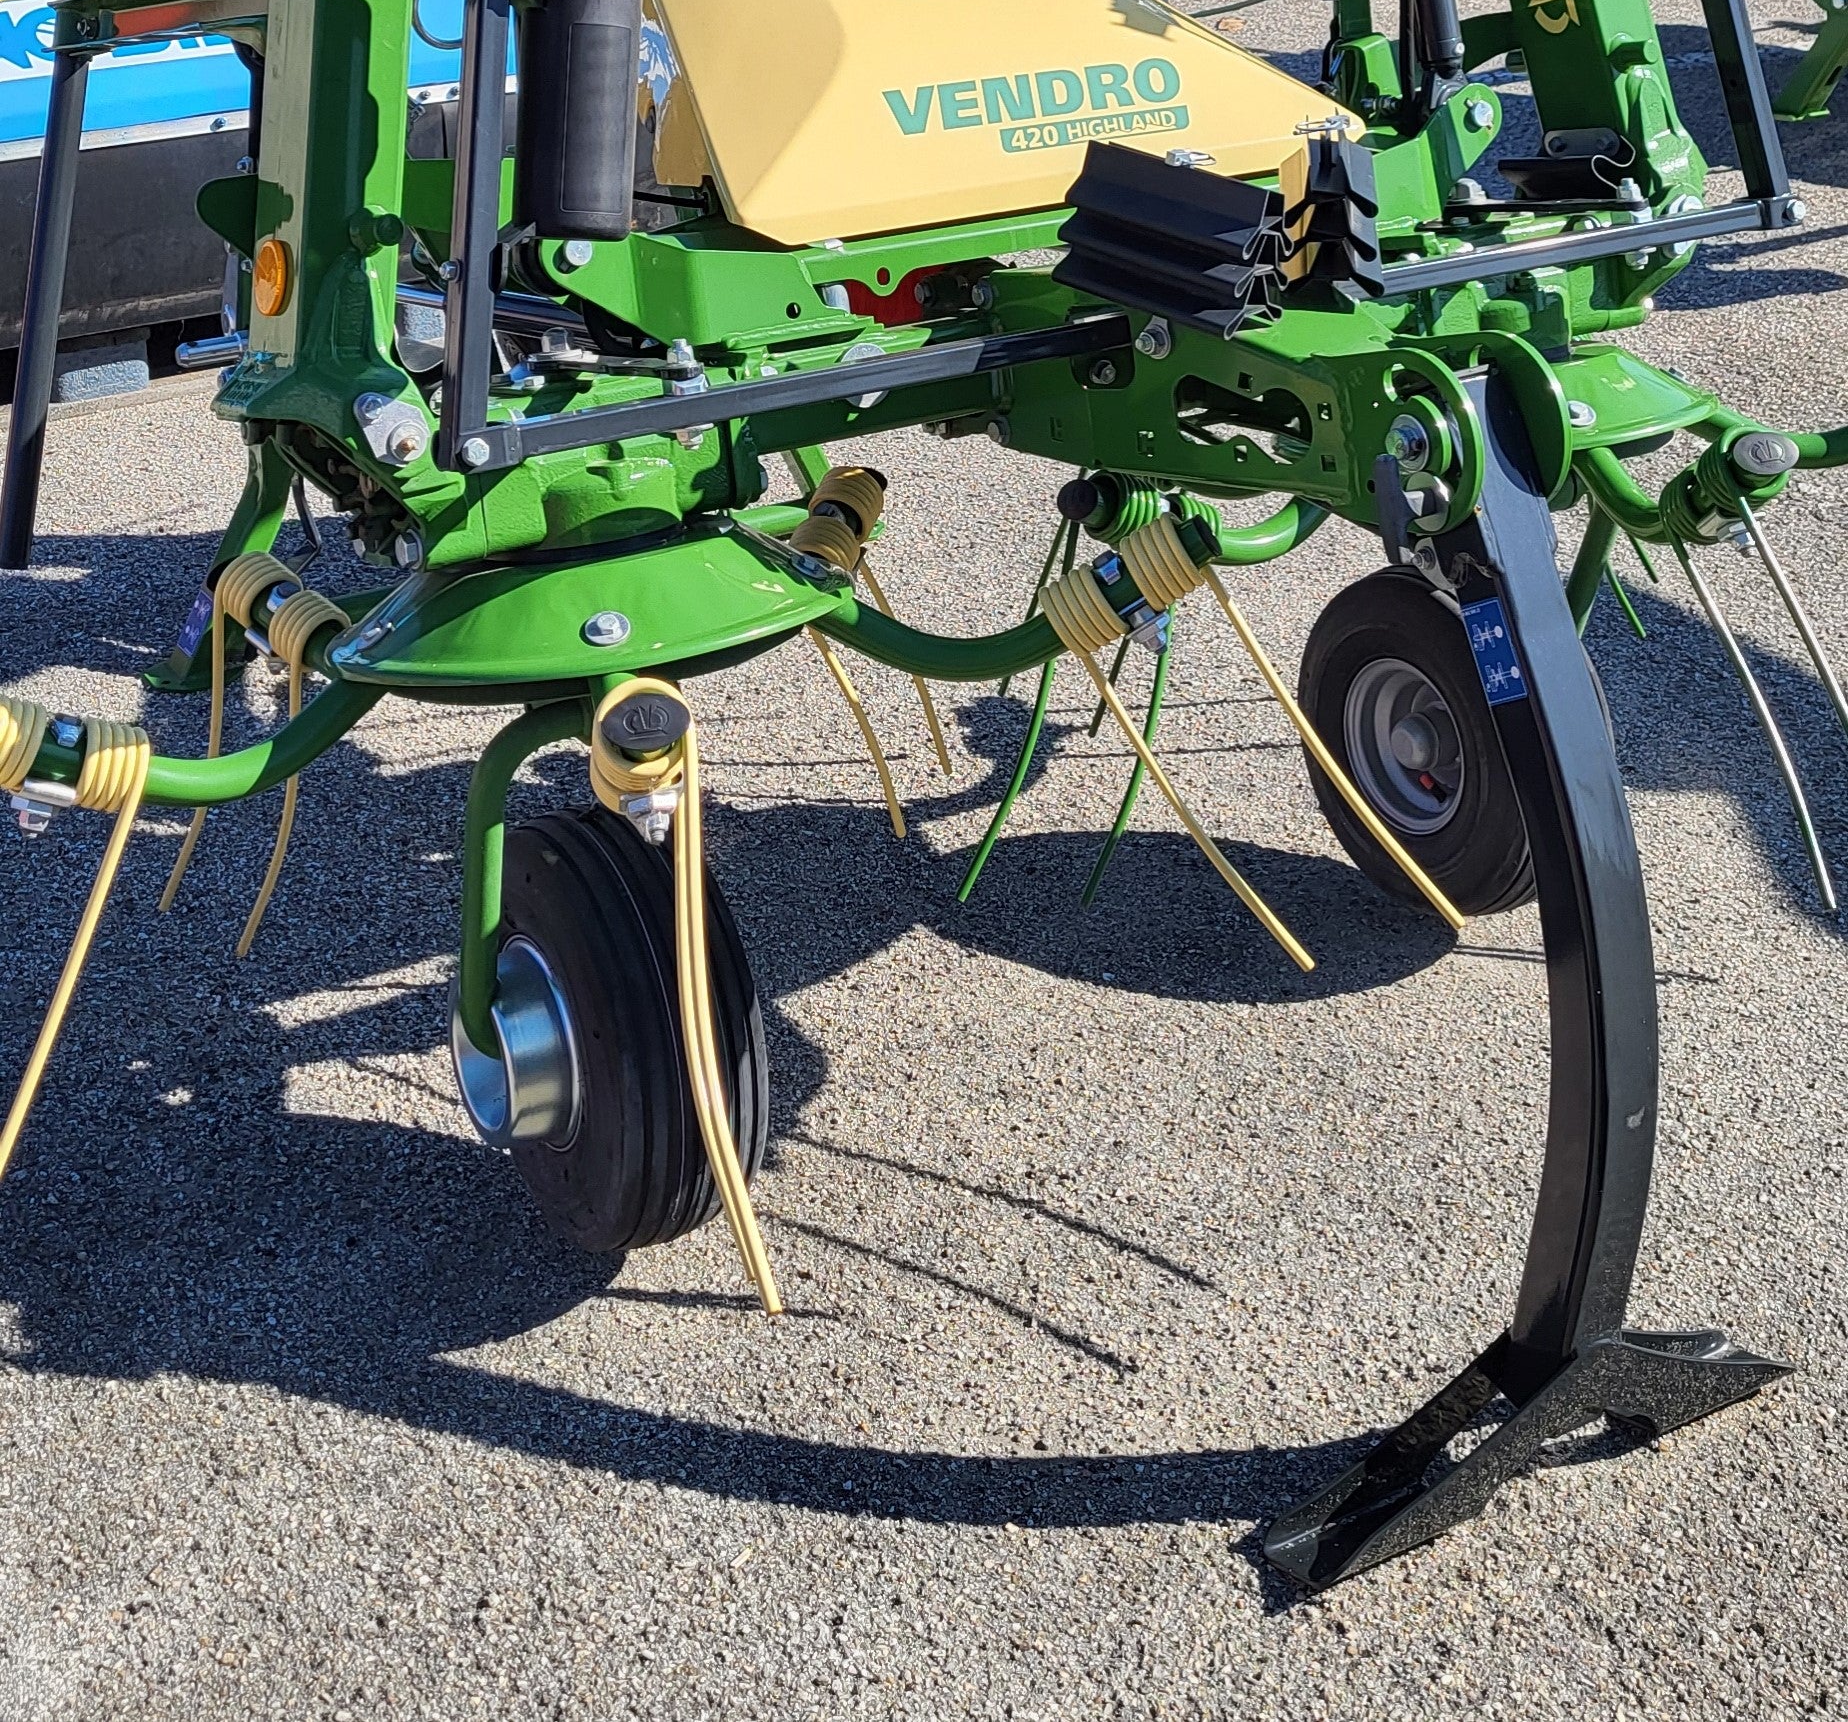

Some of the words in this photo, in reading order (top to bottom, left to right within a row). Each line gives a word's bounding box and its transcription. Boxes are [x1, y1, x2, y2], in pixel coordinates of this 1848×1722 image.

[881, 57, 1181, 136] VENDRO
[1010, 124, 1059, 150] 420
[1066, 109, 1177, 142] HIGHLAND
